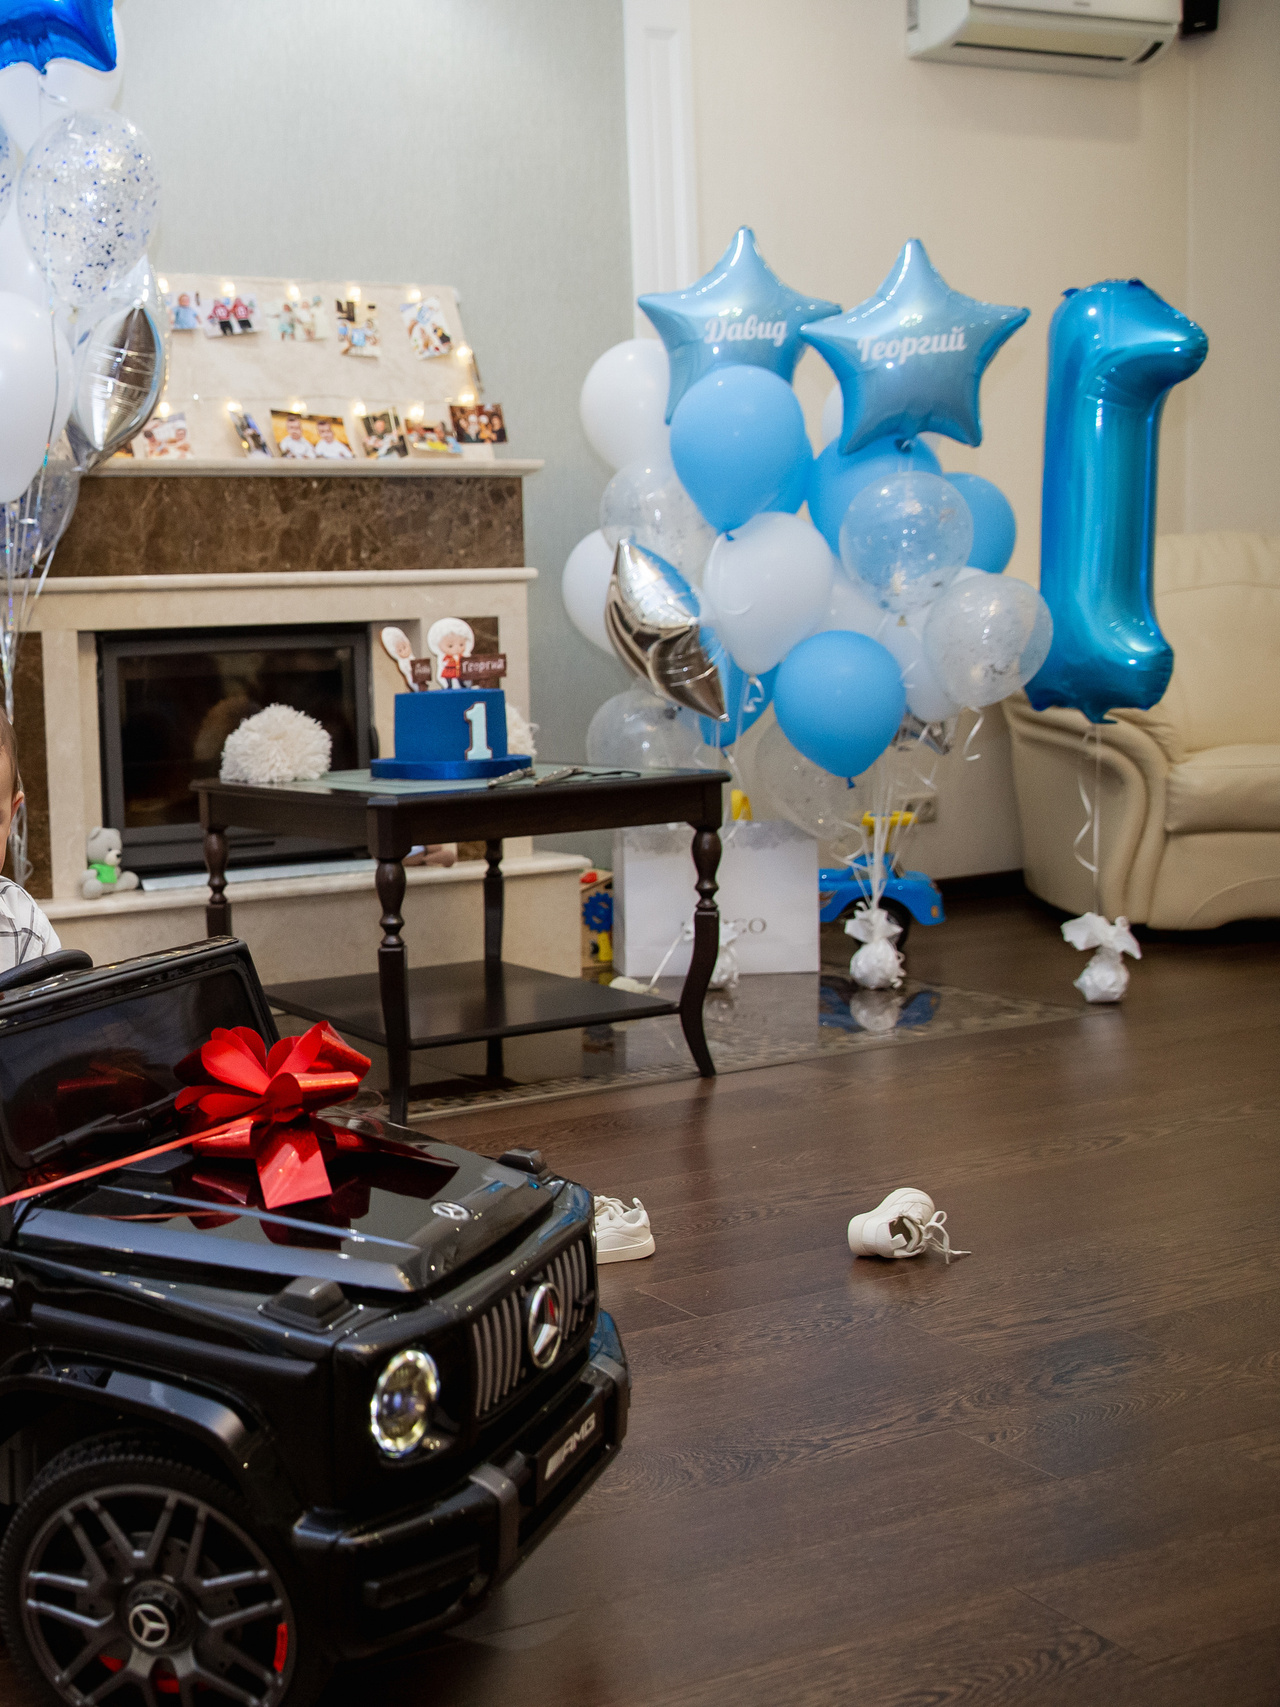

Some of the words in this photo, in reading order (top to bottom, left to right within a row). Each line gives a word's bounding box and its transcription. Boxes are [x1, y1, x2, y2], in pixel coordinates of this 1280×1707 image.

[704, 314, 787, 347] Давид
[857, 326, 967, 365] Георгий
[463, 701, 493, 761] 1
[556, 1412, 596, 1462] AMG
